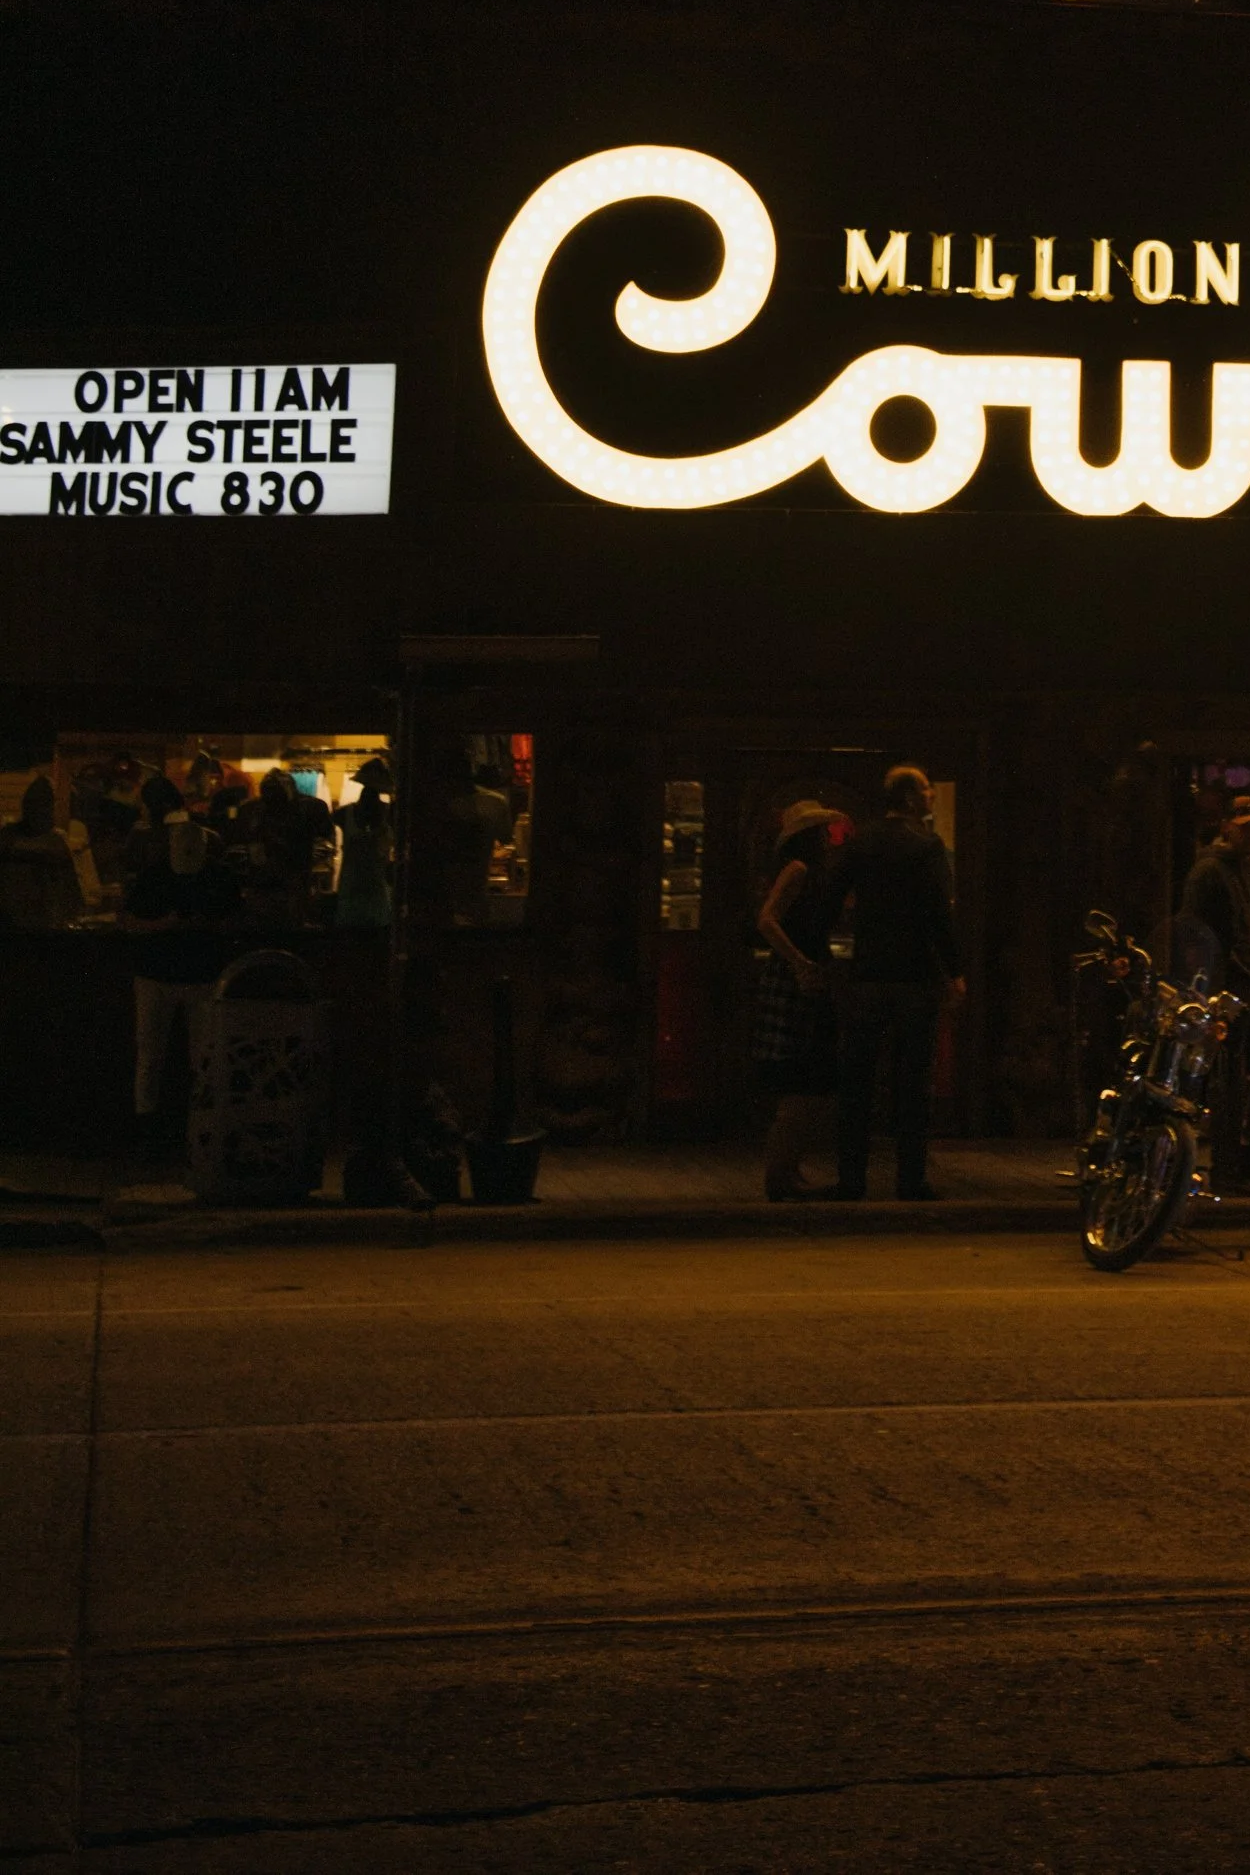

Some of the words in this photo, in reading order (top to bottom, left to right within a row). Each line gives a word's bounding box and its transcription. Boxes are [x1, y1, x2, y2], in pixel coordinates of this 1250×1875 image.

[839, 228, 1241, 306] MILLION
[74, 368, 205, 413] OPEN
[230, 366, 350, 412] 11AM
[0, 420, 168, 464] SAMMY
[186, 418, 357, 463] STEELE
[49, 471, 196, 515] MUSIC
[220, 470, 324, 515] 830
